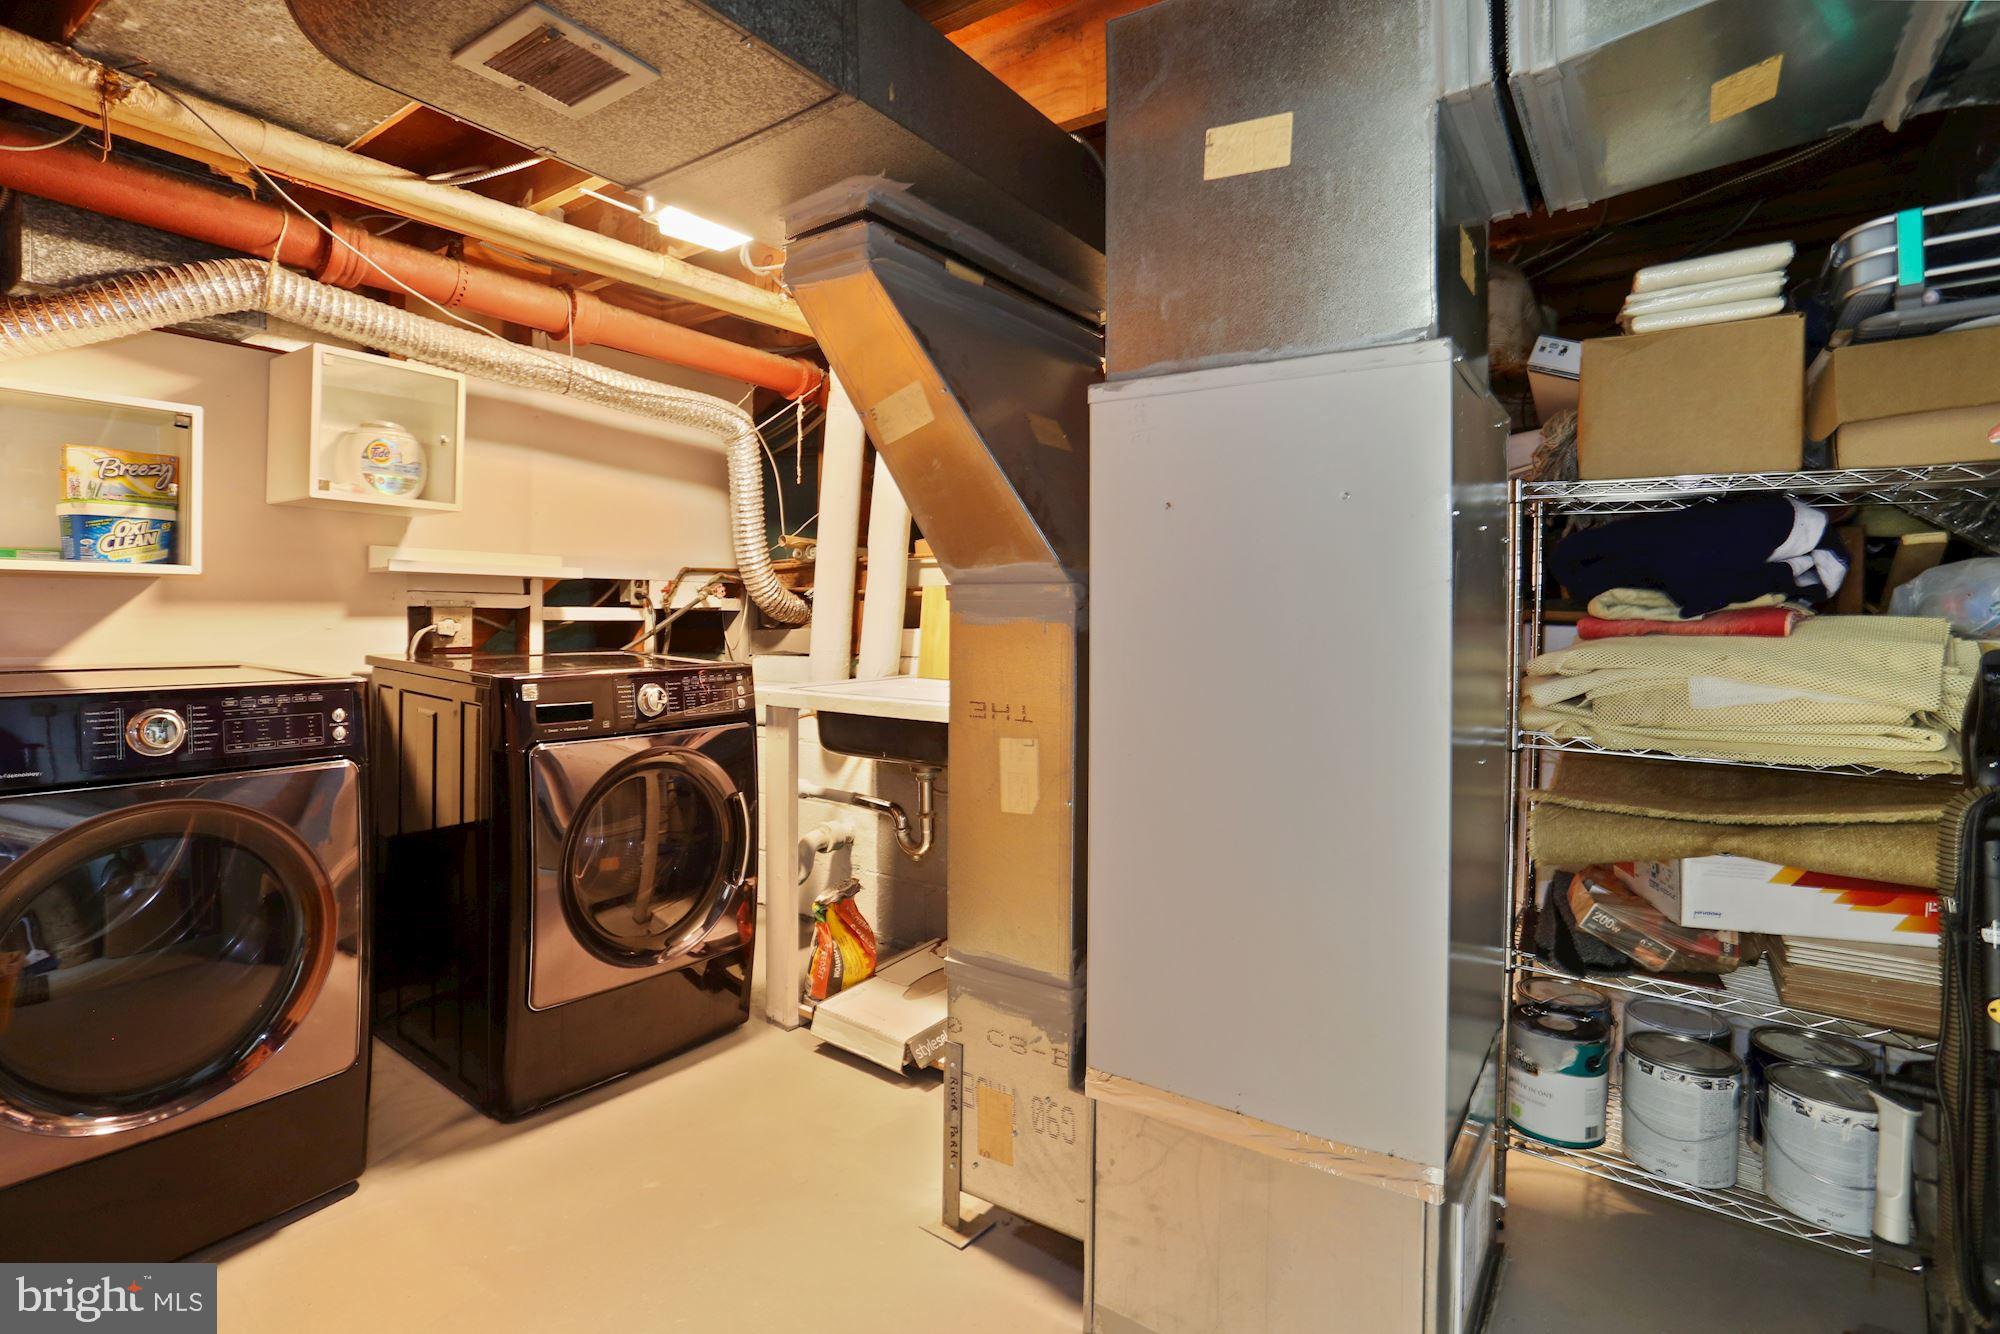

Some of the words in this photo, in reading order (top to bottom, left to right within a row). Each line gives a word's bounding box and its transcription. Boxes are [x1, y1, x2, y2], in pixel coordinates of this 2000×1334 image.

[94, 456, 174, 490] Breezy
[114, 520, 149, 538] OXI
[100, 530, 159, 552] CLEAN
